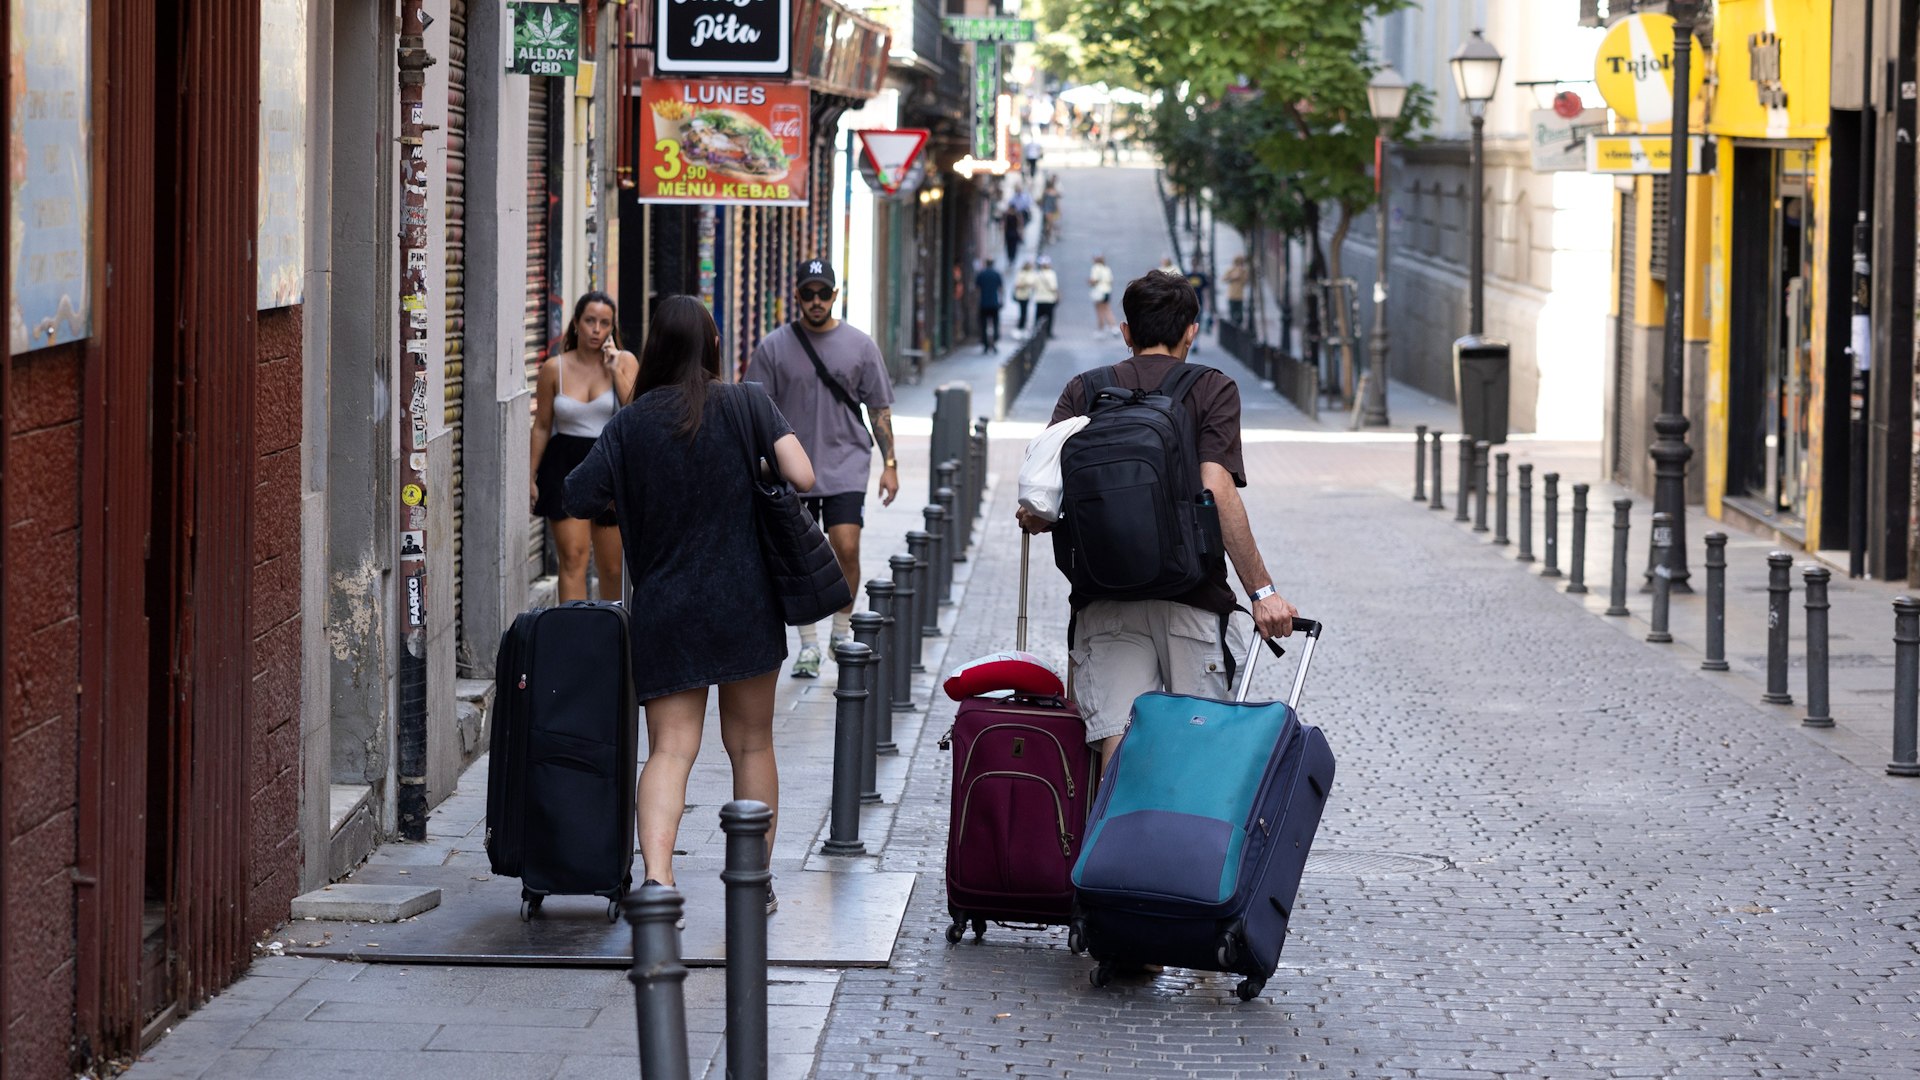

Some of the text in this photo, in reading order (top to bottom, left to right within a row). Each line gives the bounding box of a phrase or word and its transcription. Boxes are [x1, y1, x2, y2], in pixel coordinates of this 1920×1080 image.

[691, 12, 761, 47] Pita
[531, 61, 562, 74] CBD
[684, 84, 766, 105] LUNES
[722, 183, 790, 199] KEBAB
[408, 578, 421, 625] FARKO
